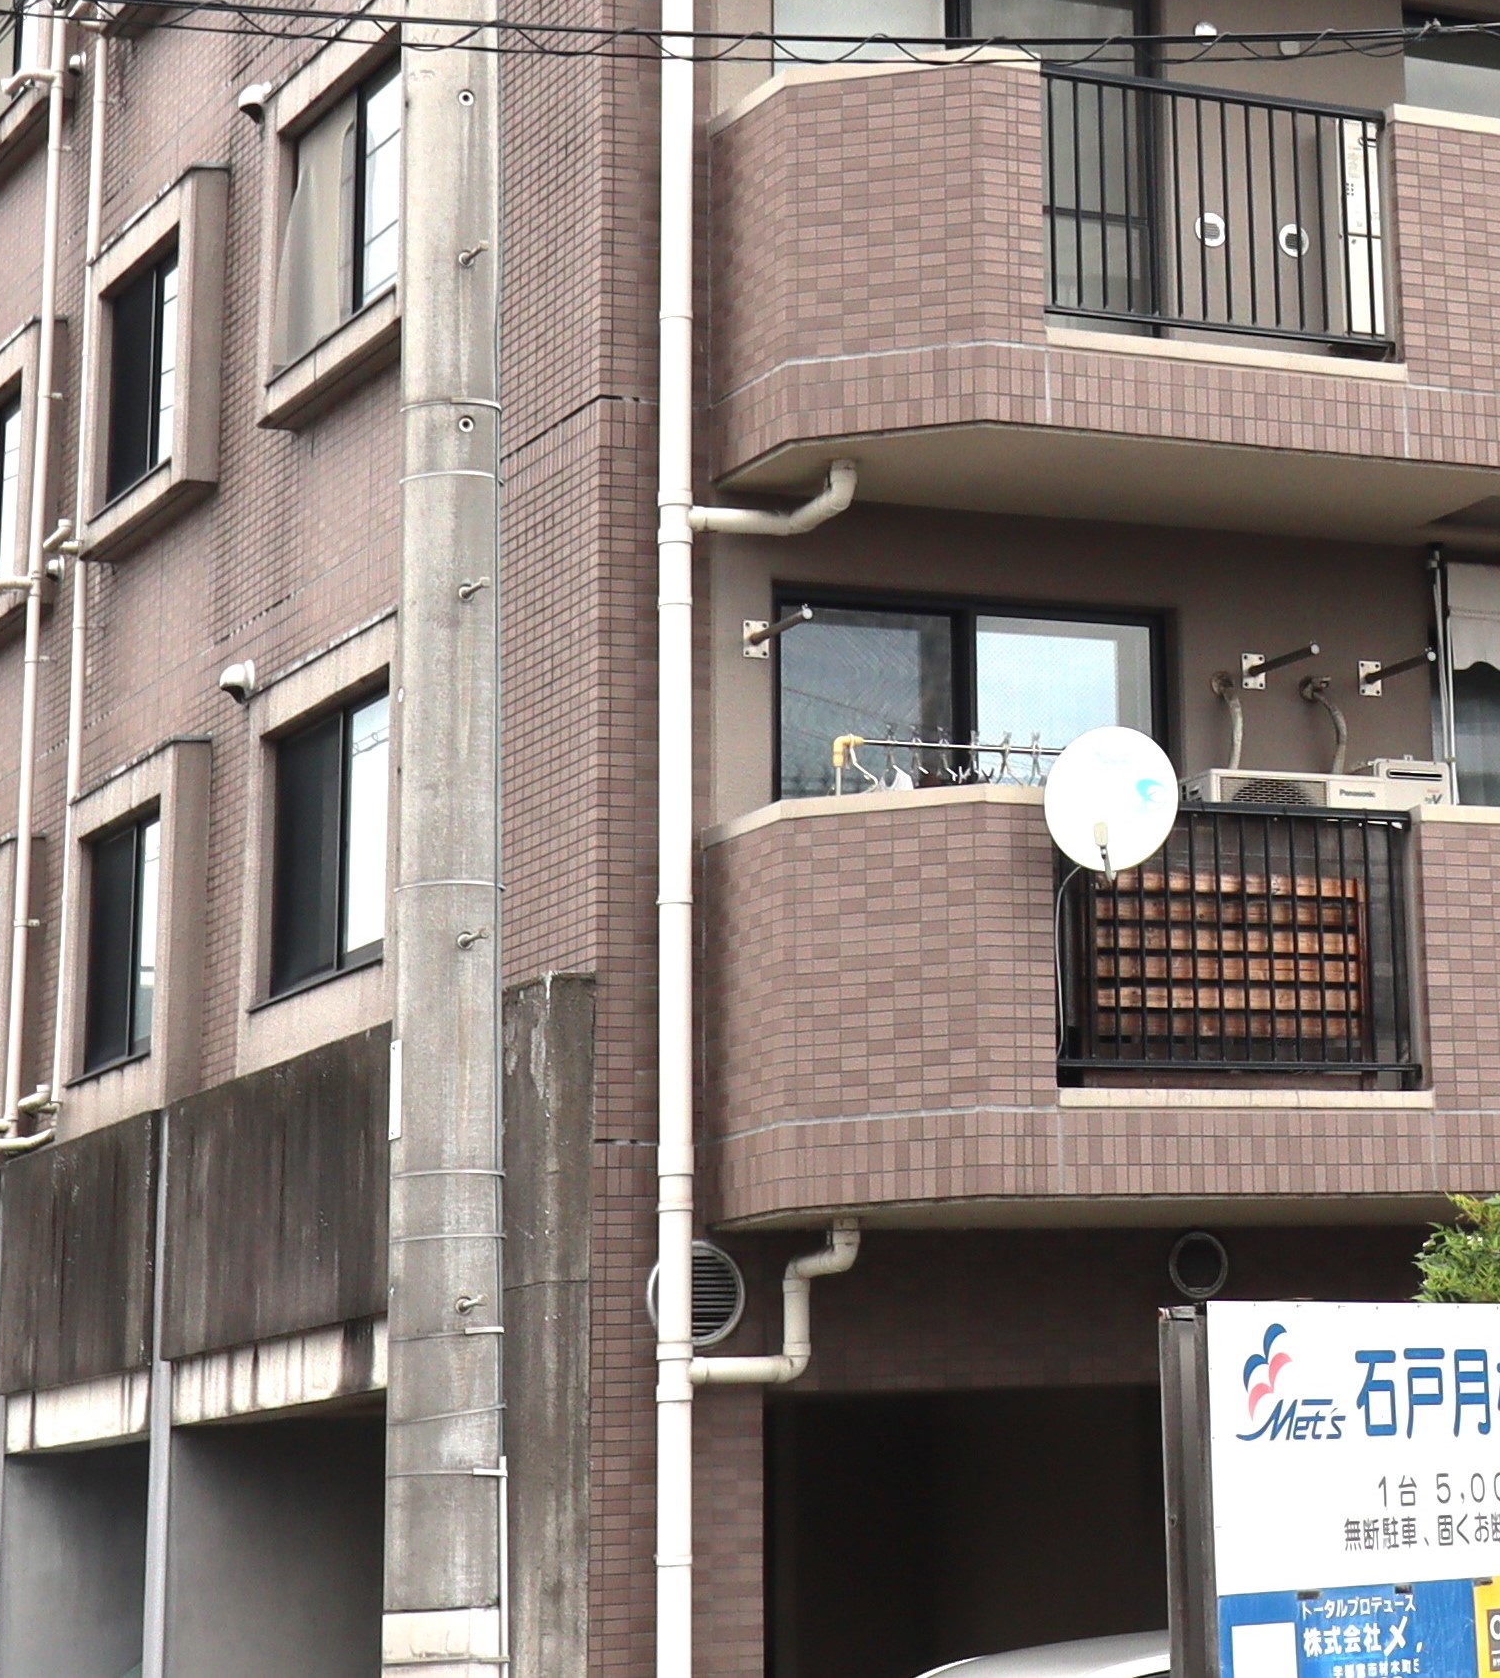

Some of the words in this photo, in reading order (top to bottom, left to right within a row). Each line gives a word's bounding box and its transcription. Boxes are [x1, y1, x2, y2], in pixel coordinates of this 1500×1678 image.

[1303, 1616, 1423, 1658] 株式会社メ
